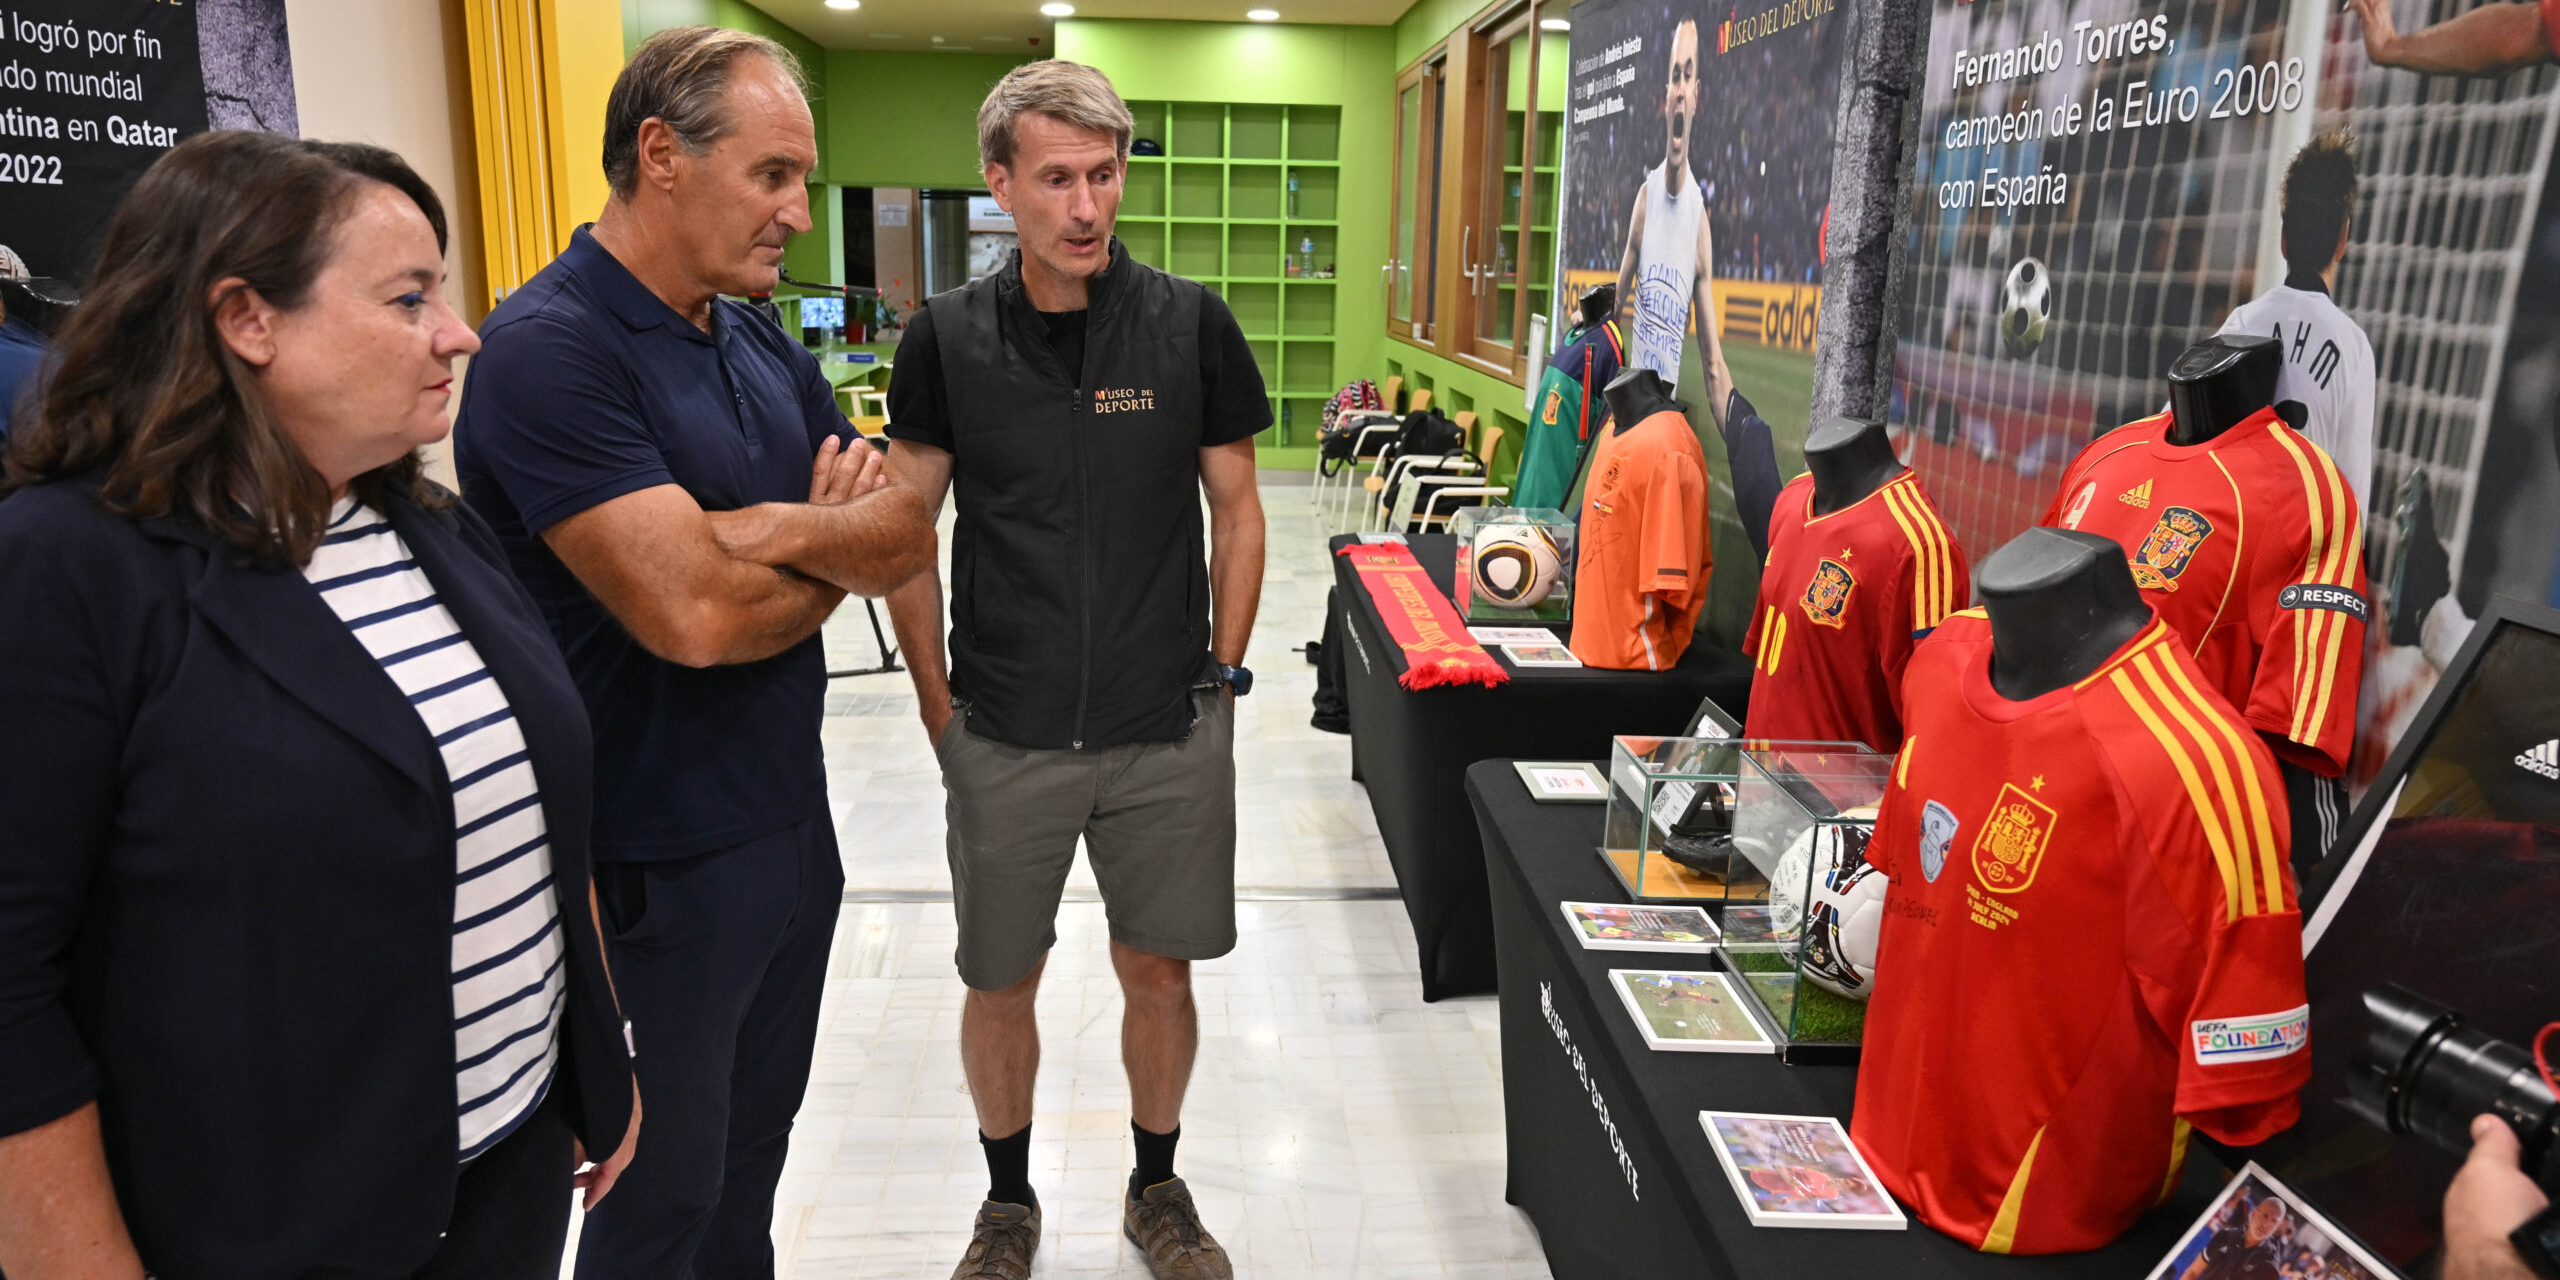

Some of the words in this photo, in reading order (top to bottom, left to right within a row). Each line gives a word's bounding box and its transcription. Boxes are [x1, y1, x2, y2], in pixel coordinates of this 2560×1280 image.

[13, 11, 79, 53] logró
[88, 29, 126, 58] por
[134, 28, 161, 59] fin
[1760, 7, 1778, 38] DEL
[1953, 31, 2063, 89] Fernando
[2074, 14, 2175, 66] Torres,
[45, 70, 142, 101] mundial
[1945, 101, 2042, 154] campeón
[2051, 95, 2081, 138] de
[2090, 88, 2112, 132] la
[2123, 81, 2199, 129] Euro
[2210, 57, 2303, 119] 2008
[68, 119, 98, 142] en
[107, 115, 177, 147] Qatar
[0, 153, 63, 185] 2022
[1939, 175, 1975, 209] con
[1981, 165, 2067, 216] España
[1766, 285, 1820, 346] adid
[1095, 387, 1135, 400] MUSEO
[1141, 389, 1155, 397] DEL
[1095, 398, 1155, 413] DEPORTE
[2118, 493, 2151, 509] adidas
[2302, 589, 2367, 615] RESPECT
[1757, 604, 1787, 677] 10
[1970, 911, 1998, 931] BERLIN
[1986, 896, 2019, 920] ENGLAND
[1989, 909, 2010, 926] 2024
[2197, 1022, 2228, 1034] UEFA
[2198, 1020, 2308, 1049] FOUNDATION
[1572, 1044, 1590, 1092] DEL
[1591, 1077, 1640, 1202] DEPORTE
